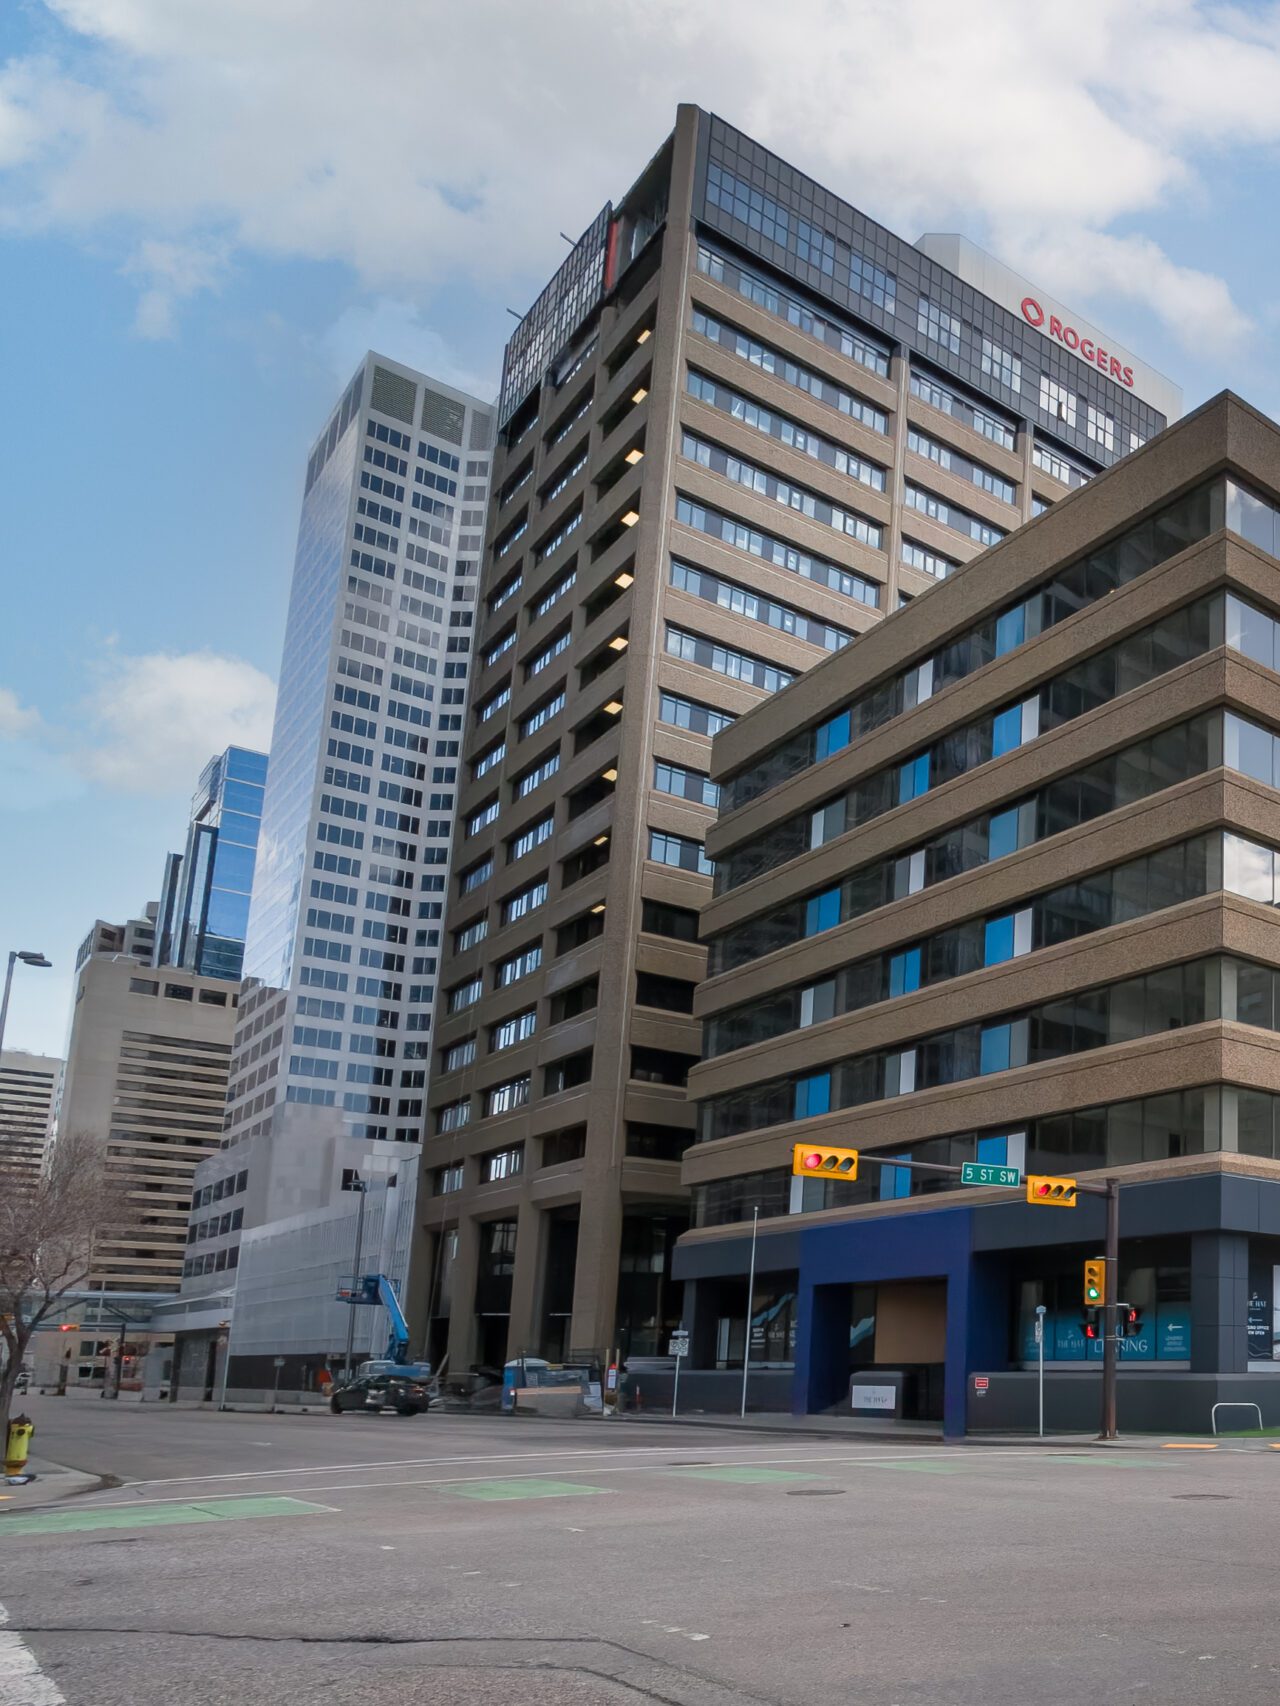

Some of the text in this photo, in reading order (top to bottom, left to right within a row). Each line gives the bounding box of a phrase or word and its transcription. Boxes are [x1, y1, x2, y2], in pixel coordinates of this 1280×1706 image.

[1049, 314, 1134, 388] ROGERS
[966, 1167, 1016, 1183] 5 ST SW
